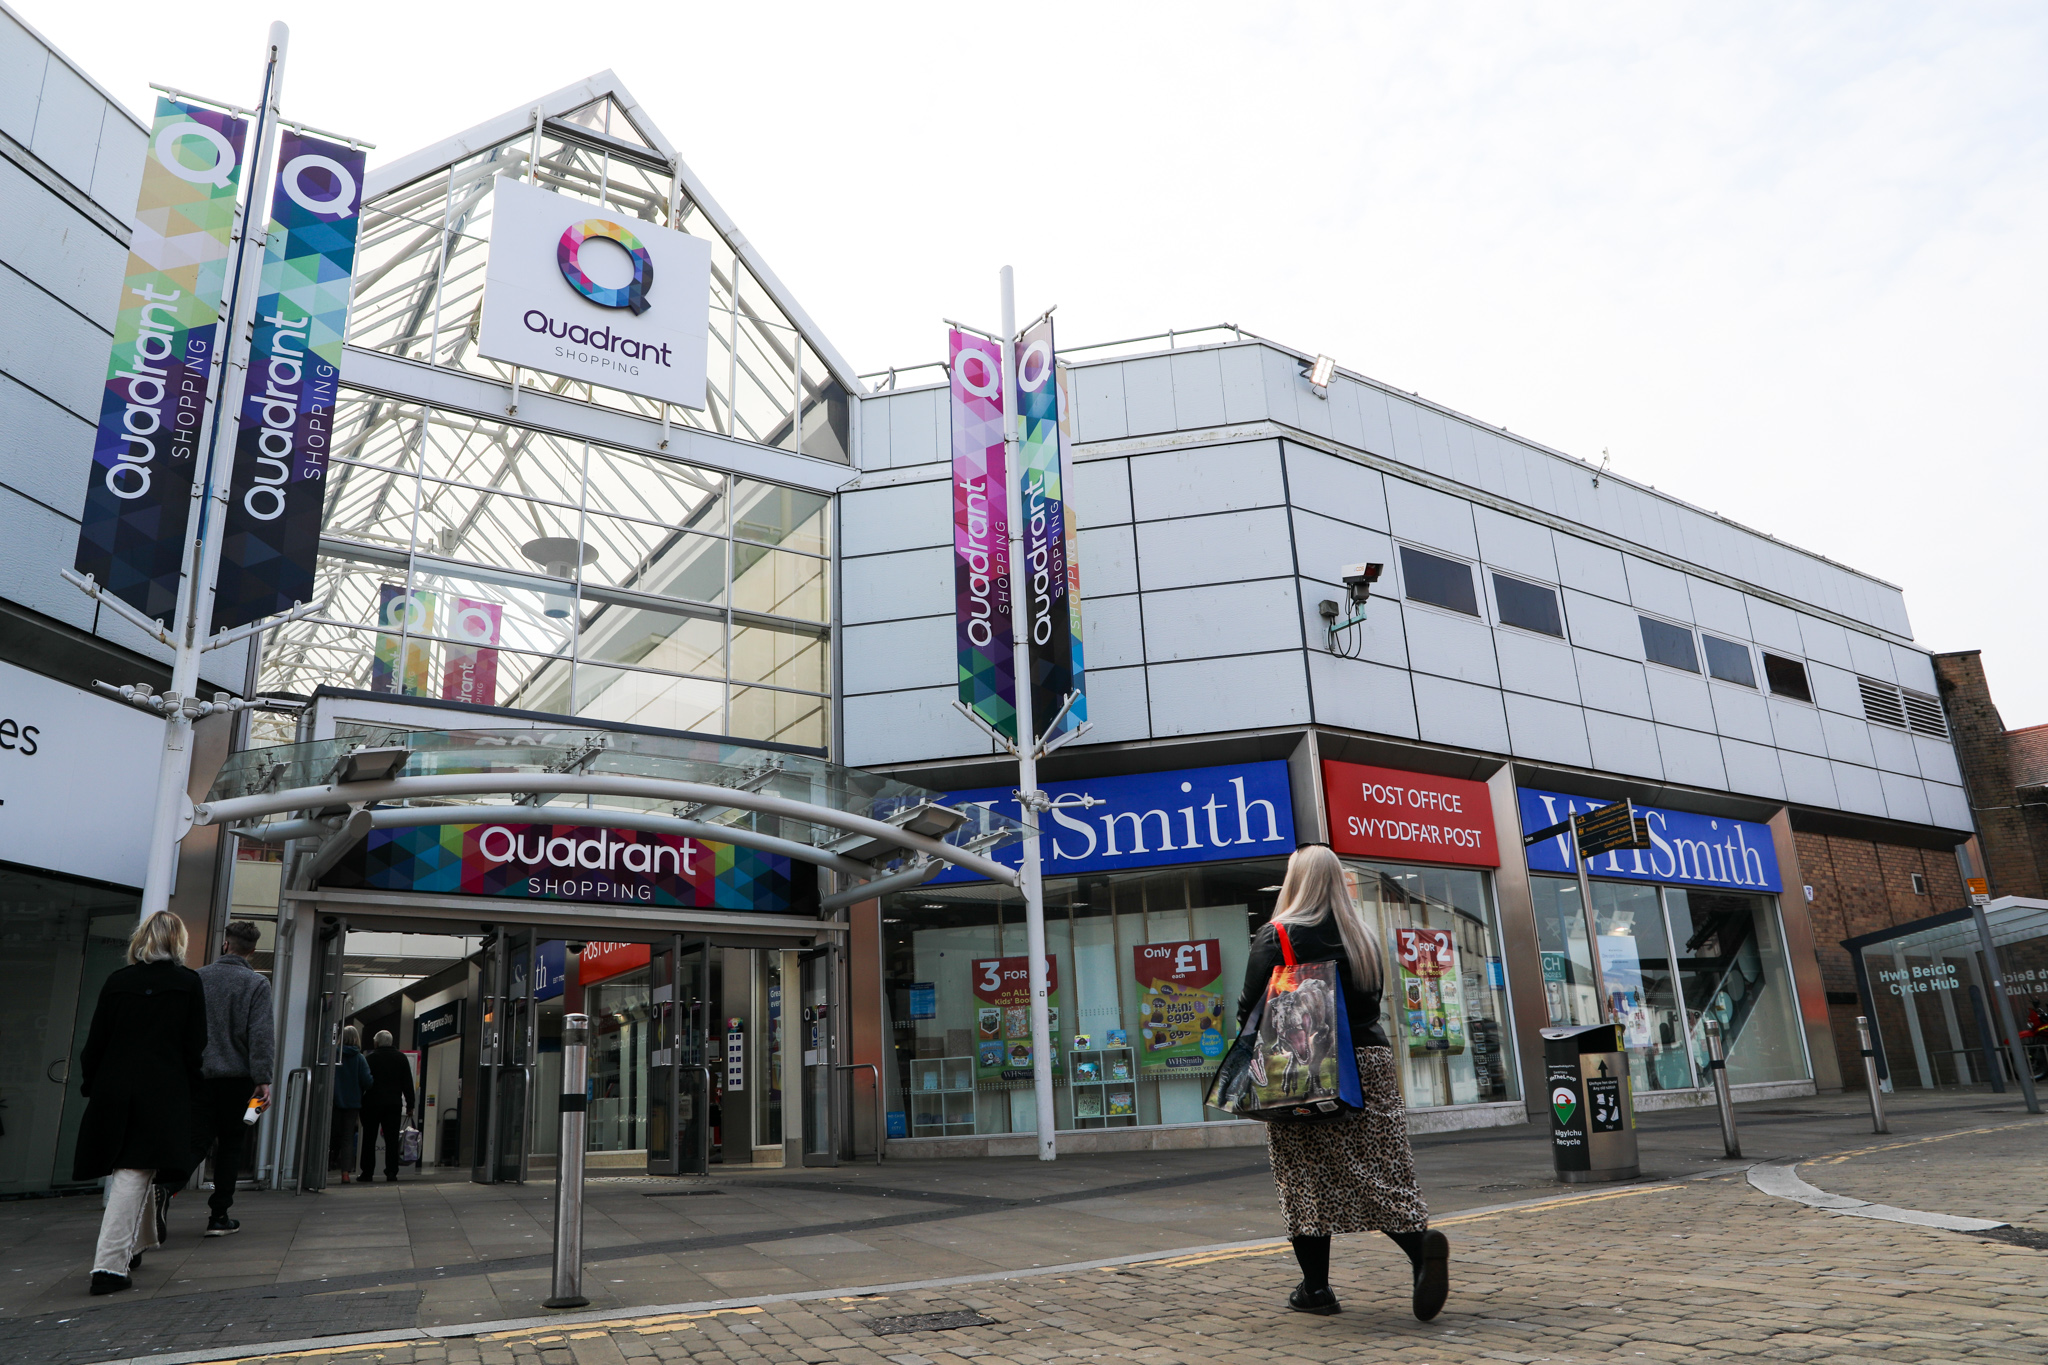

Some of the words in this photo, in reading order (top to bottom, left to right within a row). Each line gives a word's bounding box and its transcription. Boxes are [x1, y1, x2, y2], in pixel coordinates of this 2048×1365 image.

[155, 121, 235, 190] Q
[282, 154, 356, 218] Q
[556, 219, 653, 317] Q
[523, 309, 671, 367] Quadrant
[555, 345, 640, 376] SHOPPING
[106, 284, 180, 499] Quadrant
[955, 348, 999, 401] Q
[1018, 340, 1051, 393] Q
[171, 339, 207, 458] SHOPPING
[244, 312, 307, 520] Quadrant
[303, 364, 333, 480] SHOPPING
[960, 478, 992, 647] Quadrant
[995, 520, 1010, 616] SHOPPING
[1025, 474, 1051, 646] Quadrant
[1051, 501, 1064, 598] SHOPPING
[1067, 540, 1081, 630] SHOPPING
[457, 663, 475, 703] drant
[1362, 783, 1402, 806] POST
[1408, 788, 1463, 813] OFFICE
[479, 826, 697, 876] Quadrant
[1348, 817, 1442, 845] SWYDDFA'R
[1445, 827, 1482, 848] POST
[528, 878, 651, 900] SHOPPING
[1144, 947, 1172, 959] Only
[1175, 943, 1209, 974] £1
[1402, 932, 1419, 962] 3
[1419, 943, 1436, 952] FOR
[1434, 933, 1451, 962] 2
[1879, 968, 1909, 982] Hwb
[1912, 963, 1956, 978] Beicio
[980, 961, 1001, 992] 3
[1004, 970, 1028, 980] FOR
[1013, 989, 1030, 997] ALL
[1890, 981, 1928, 997] Cycle
[1931, 977, 1960, 991] Hub
[1167, 1001, 1192, 1015] Mini
[1167, 1012, 1196, 1024] eggs
[1168, 1057, 1203, 1065] WHSmith
